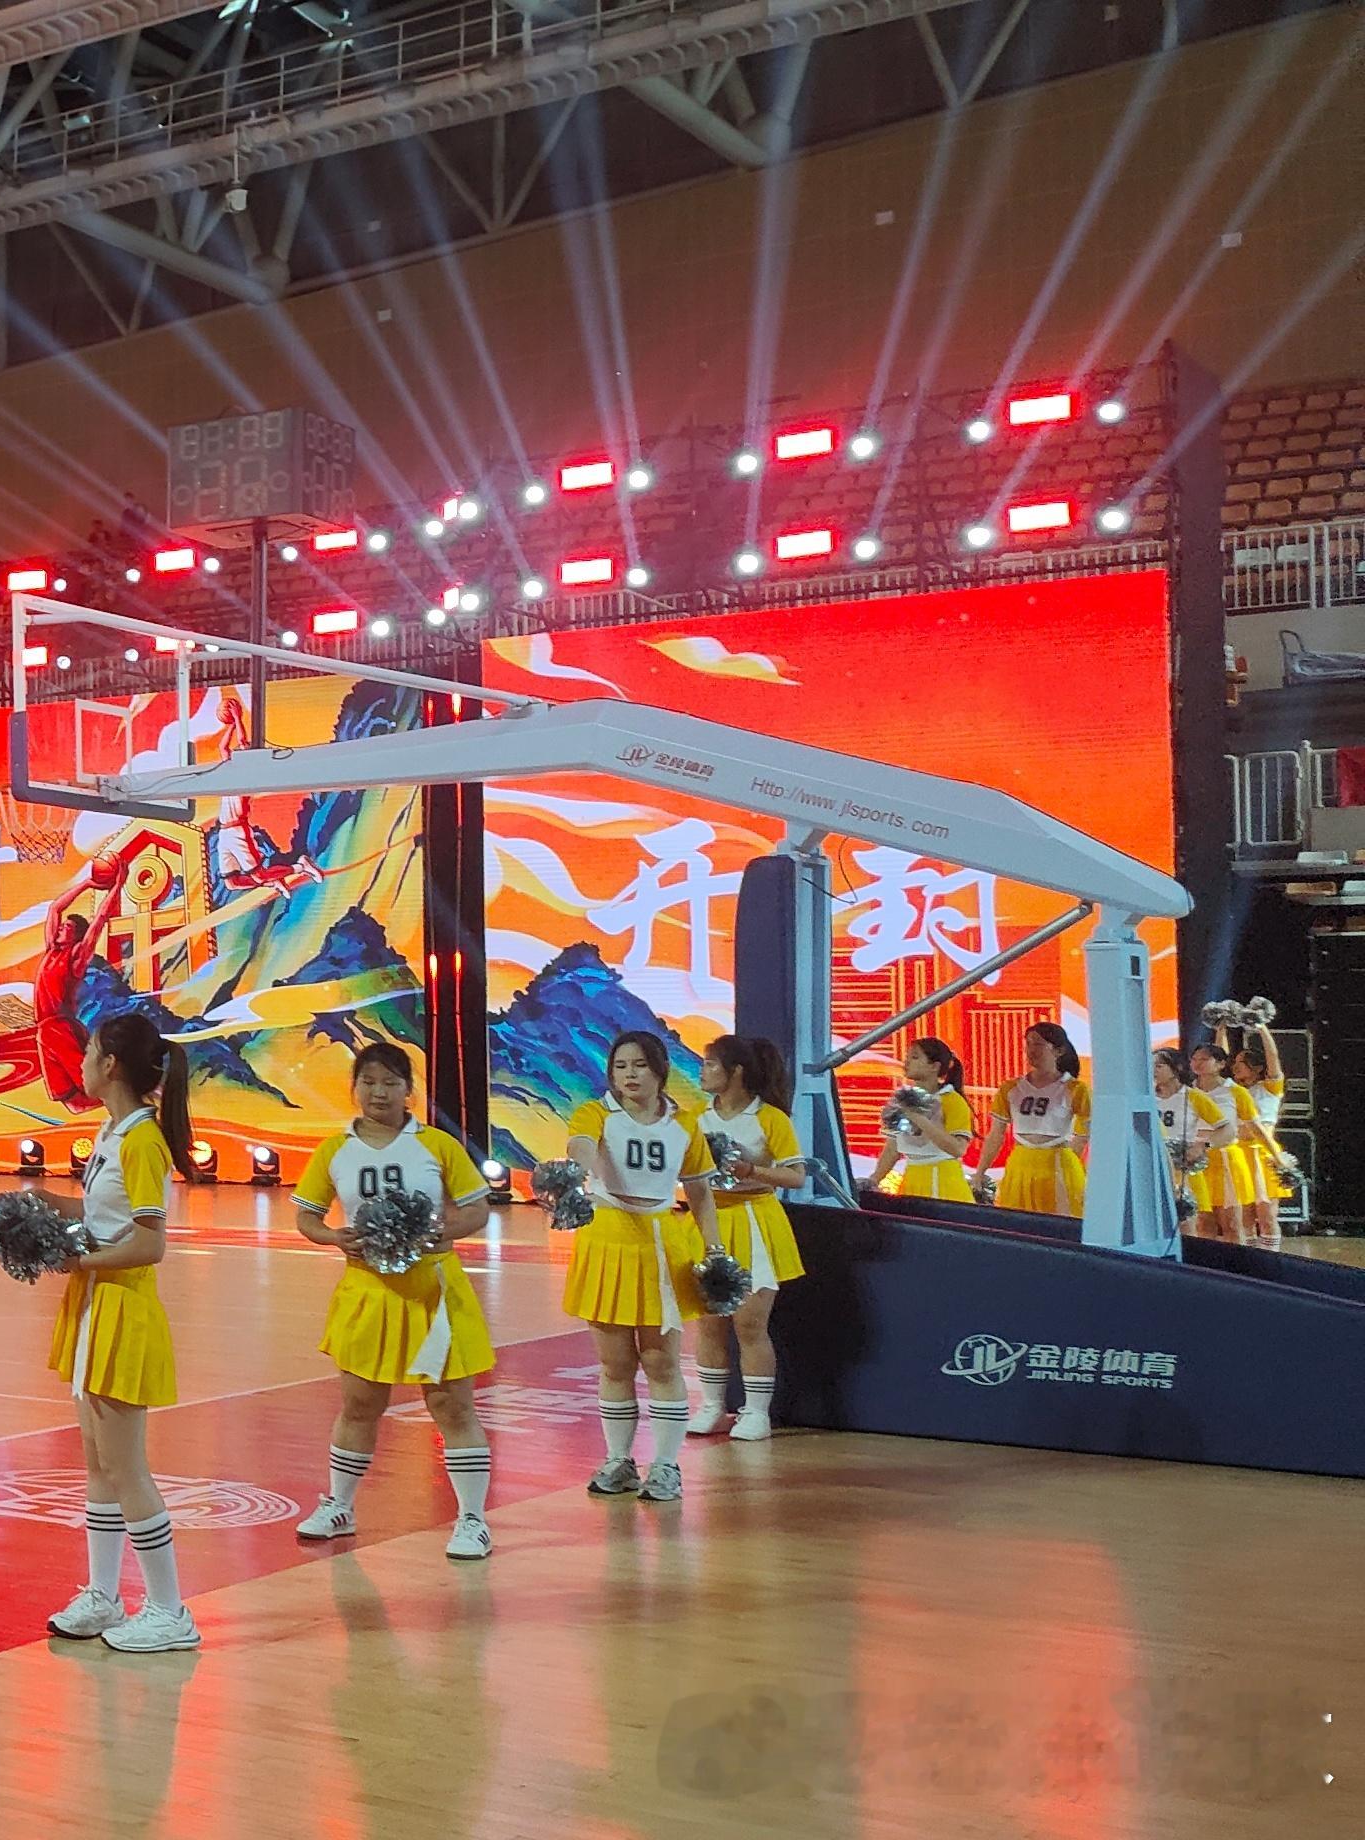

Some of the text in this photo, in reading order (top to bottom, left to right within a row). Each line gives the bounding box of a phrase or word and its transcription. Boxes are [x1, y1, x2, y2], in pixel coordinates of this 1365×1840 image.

[587, 818, 1001, 1000] 开封
[1019, 1095, 1050, 1117] 09
[625, 1138, 667, 1173] 09
[359, 1163, 404, 1199] 09
[1026, 1343, 1177, 1378] 金陵体育
[1026, 1369, 1174, 1390] JINLING SPORTS
